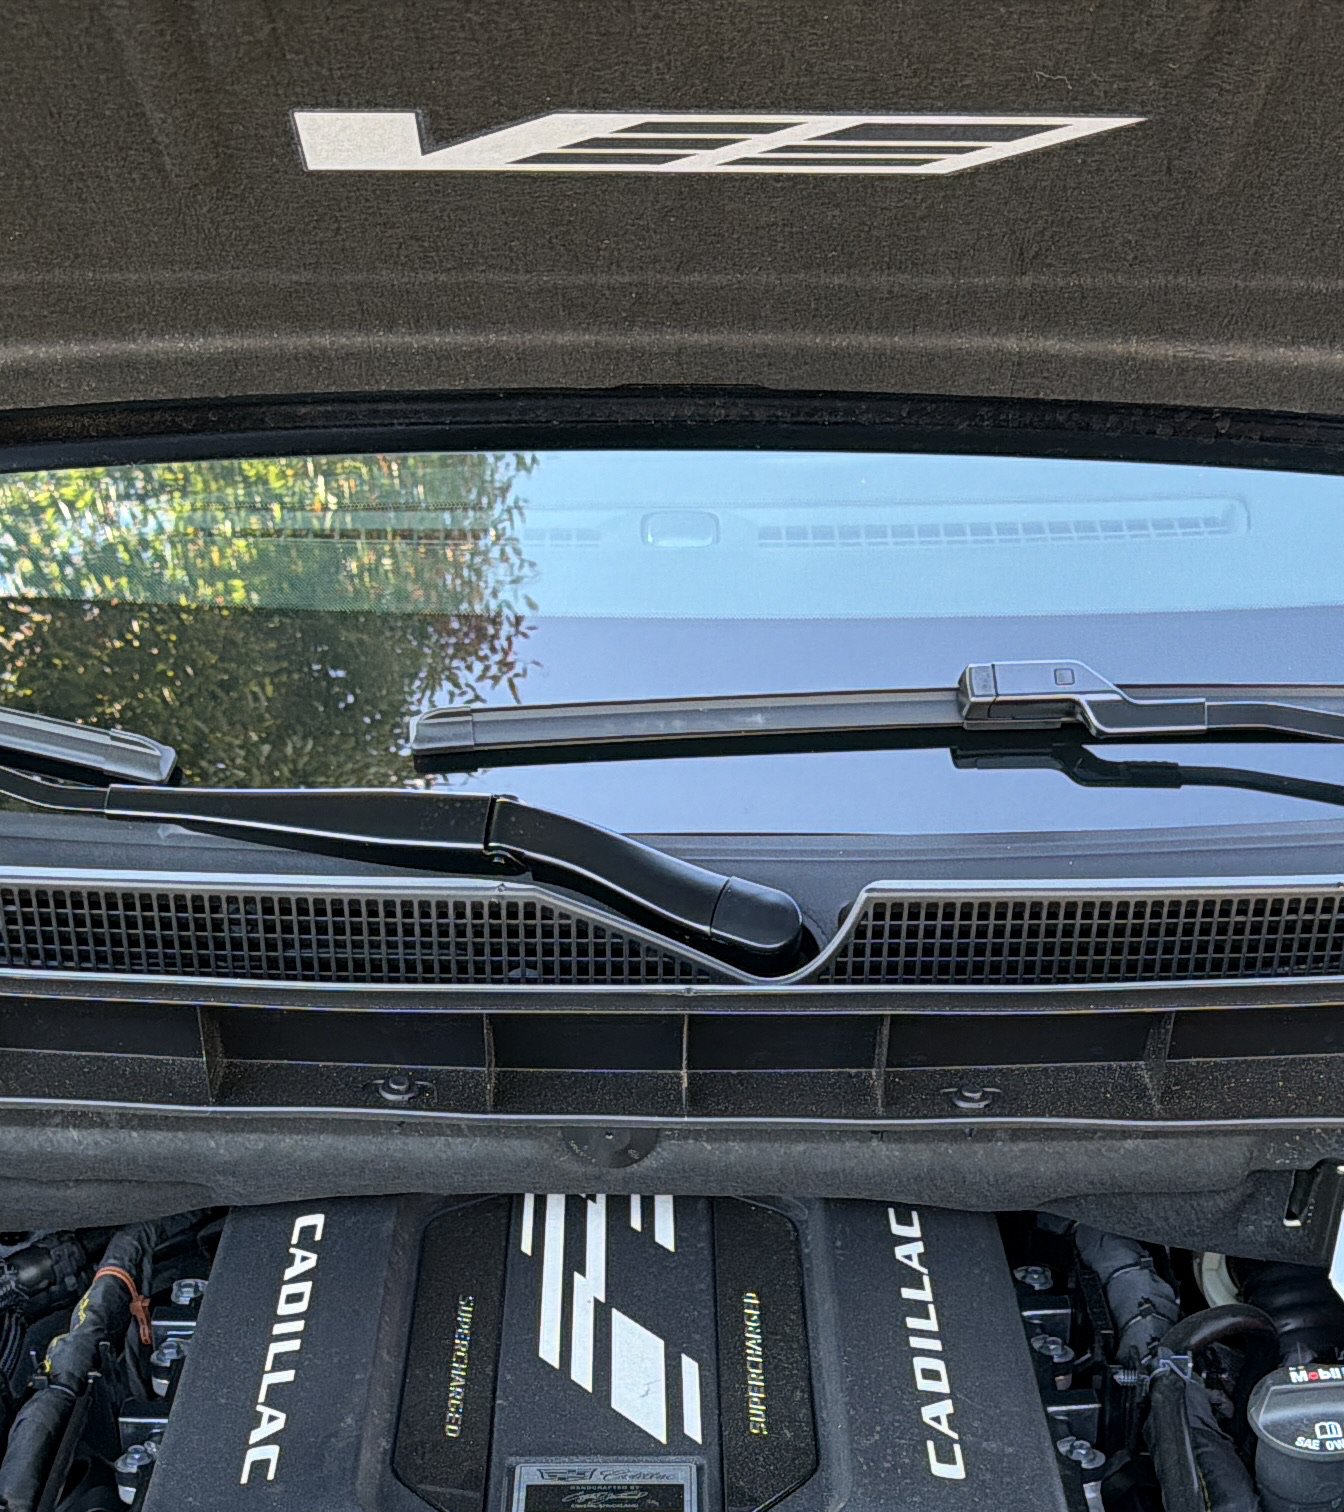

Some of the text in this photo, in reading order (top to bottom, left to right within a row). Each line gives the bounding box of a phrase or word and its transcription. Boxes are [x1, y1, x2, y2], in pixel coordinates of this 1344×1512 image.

[240, 1213, 325, 1485] CADILLAC
[445, 1294, 475, 1438] SUPERCHARGED
[743, 1290, 769, 1435] SUPERCHARGED
[888, 1207, 966, 1480] CADILLAC
[1290, 1368, 1342, 1382] Mobil
[1295, 1436, 1320, 1451] SAE
